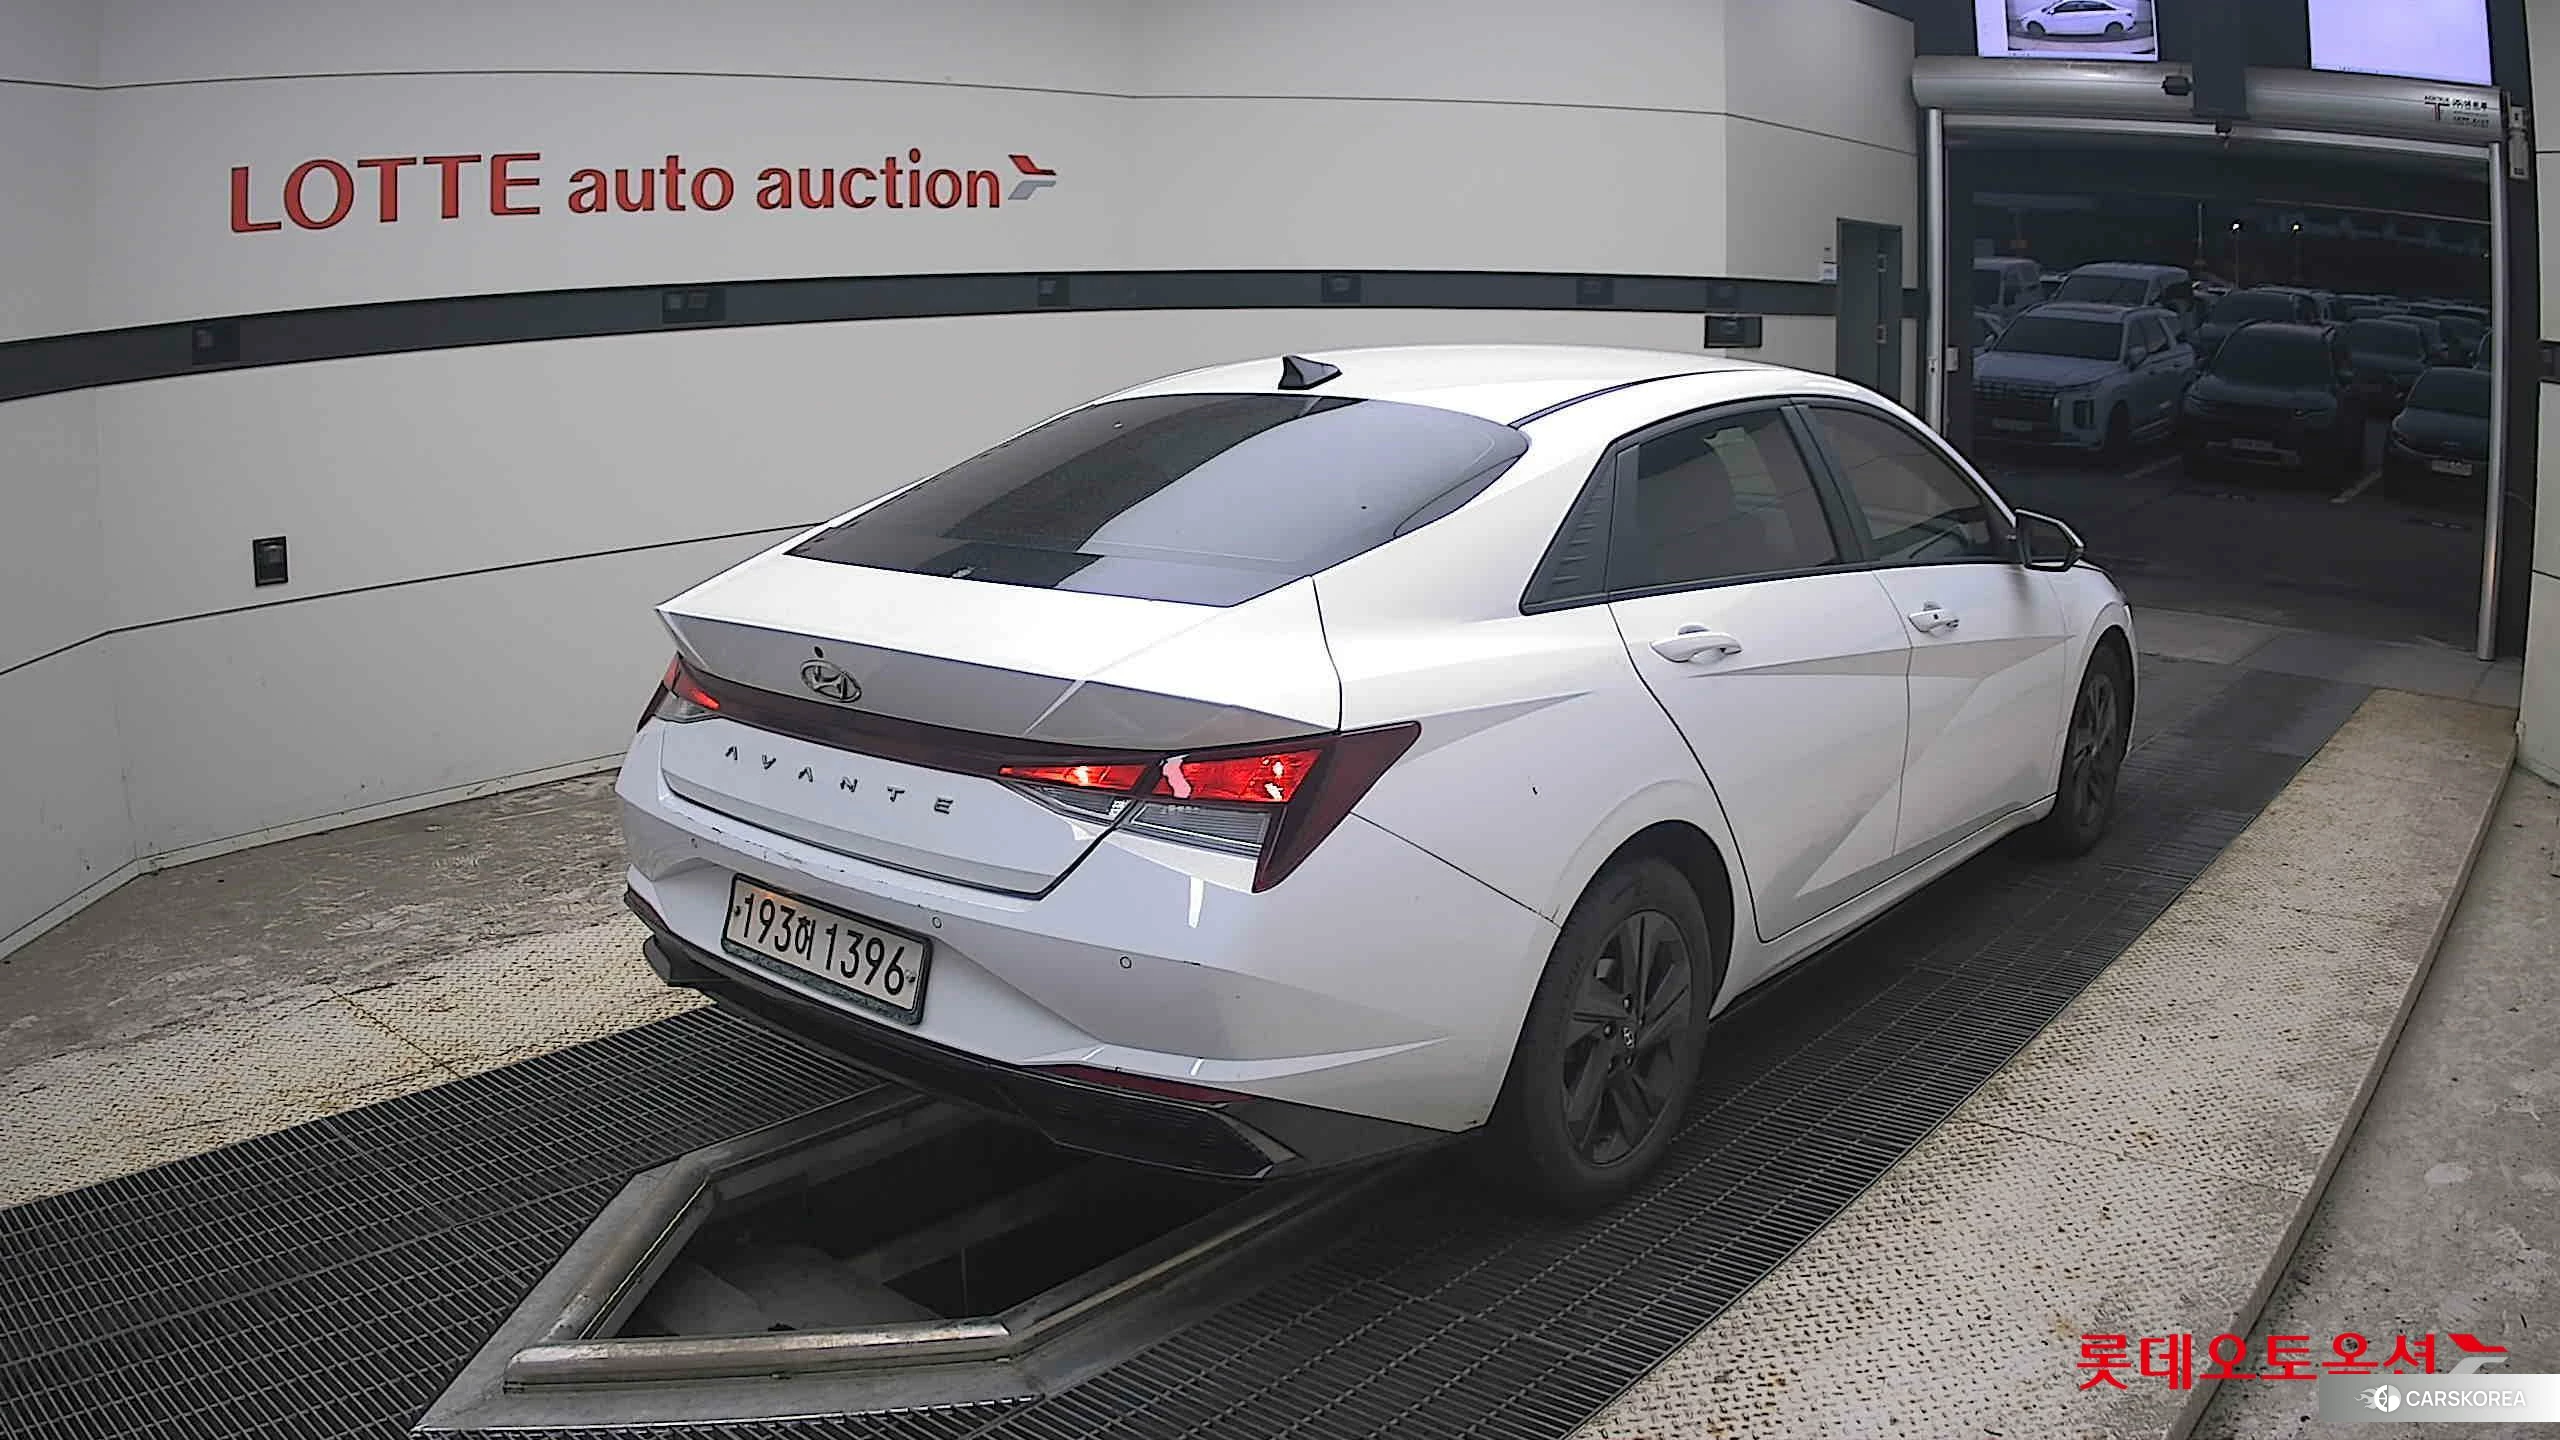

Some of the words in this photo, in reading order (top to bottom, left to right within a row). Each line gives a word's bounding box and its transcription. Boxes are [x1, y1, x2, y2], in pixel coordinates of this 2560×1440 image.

[230, 152, 541, 233] LOTTE
[567, 154, 735, 214] auto
[756, 147, 1002, 210] auction
[725, 745, 954, 815] AVANTE
[824, 923, 906, 996] 1396
